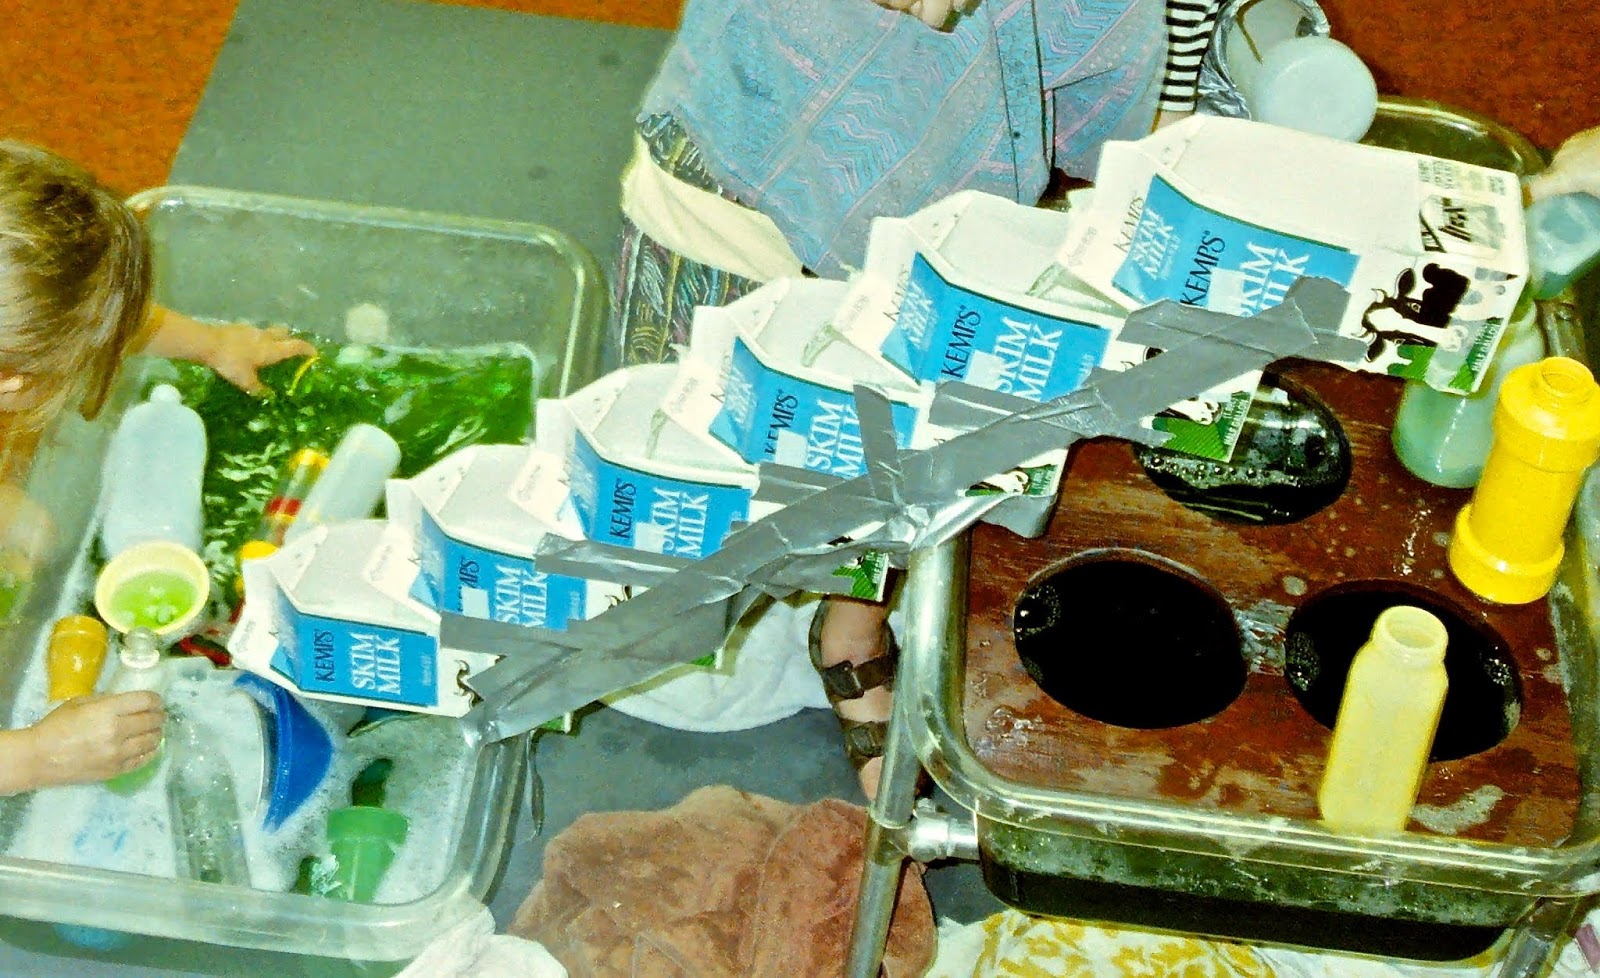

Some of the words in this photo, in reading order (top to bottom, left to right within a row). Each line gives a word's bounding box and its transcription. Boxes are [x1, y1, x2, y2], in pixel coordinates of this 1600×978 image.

[1142, 223, 1173, 279] MILK
[1180, 233, 1226, 307] KEMPS
[1260, 247, 1309, 308] ILK
[939, 308, 981, 377] KEMPS
[1012, 324, 1062, 402] MILK
[804, 399, 845, 471] SKIM
[608, 480, 637, 538] KEMPS
[674, 491, 708, 556] MILK
[494, 565, 522, 623] SKIM
[519, 570, 547, 626] MILK
[314, 629, 334, 681] KEMPS
[350, 632, 375, 689] SKIM
[374, 634, 400, 693] MILK
